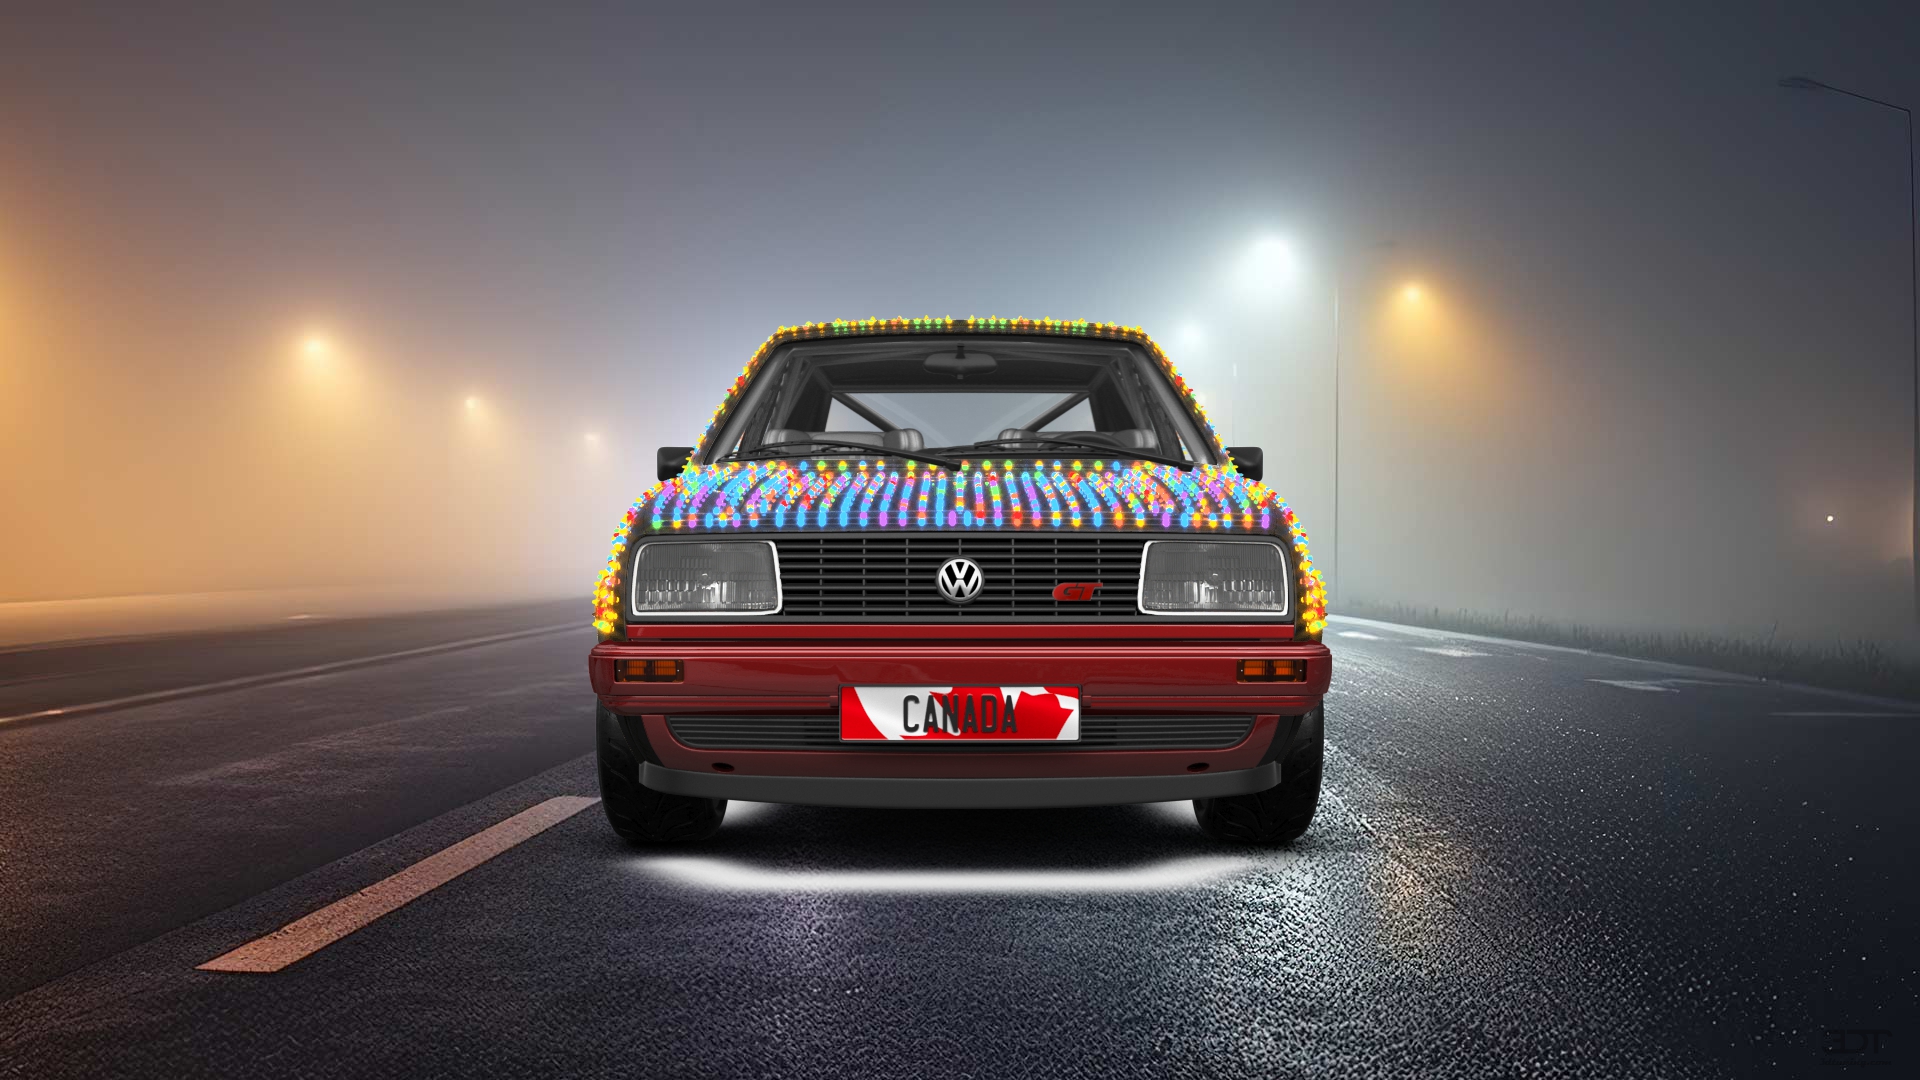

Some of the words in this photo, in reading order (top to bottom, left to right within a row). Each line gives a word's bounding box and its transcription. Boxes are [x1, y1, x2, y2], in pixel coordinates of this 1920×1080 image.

[938, 558, 982, 602] VW
[1052, 582, 1103, 601] GT
[903, 694, 1017, 733] CANADA
